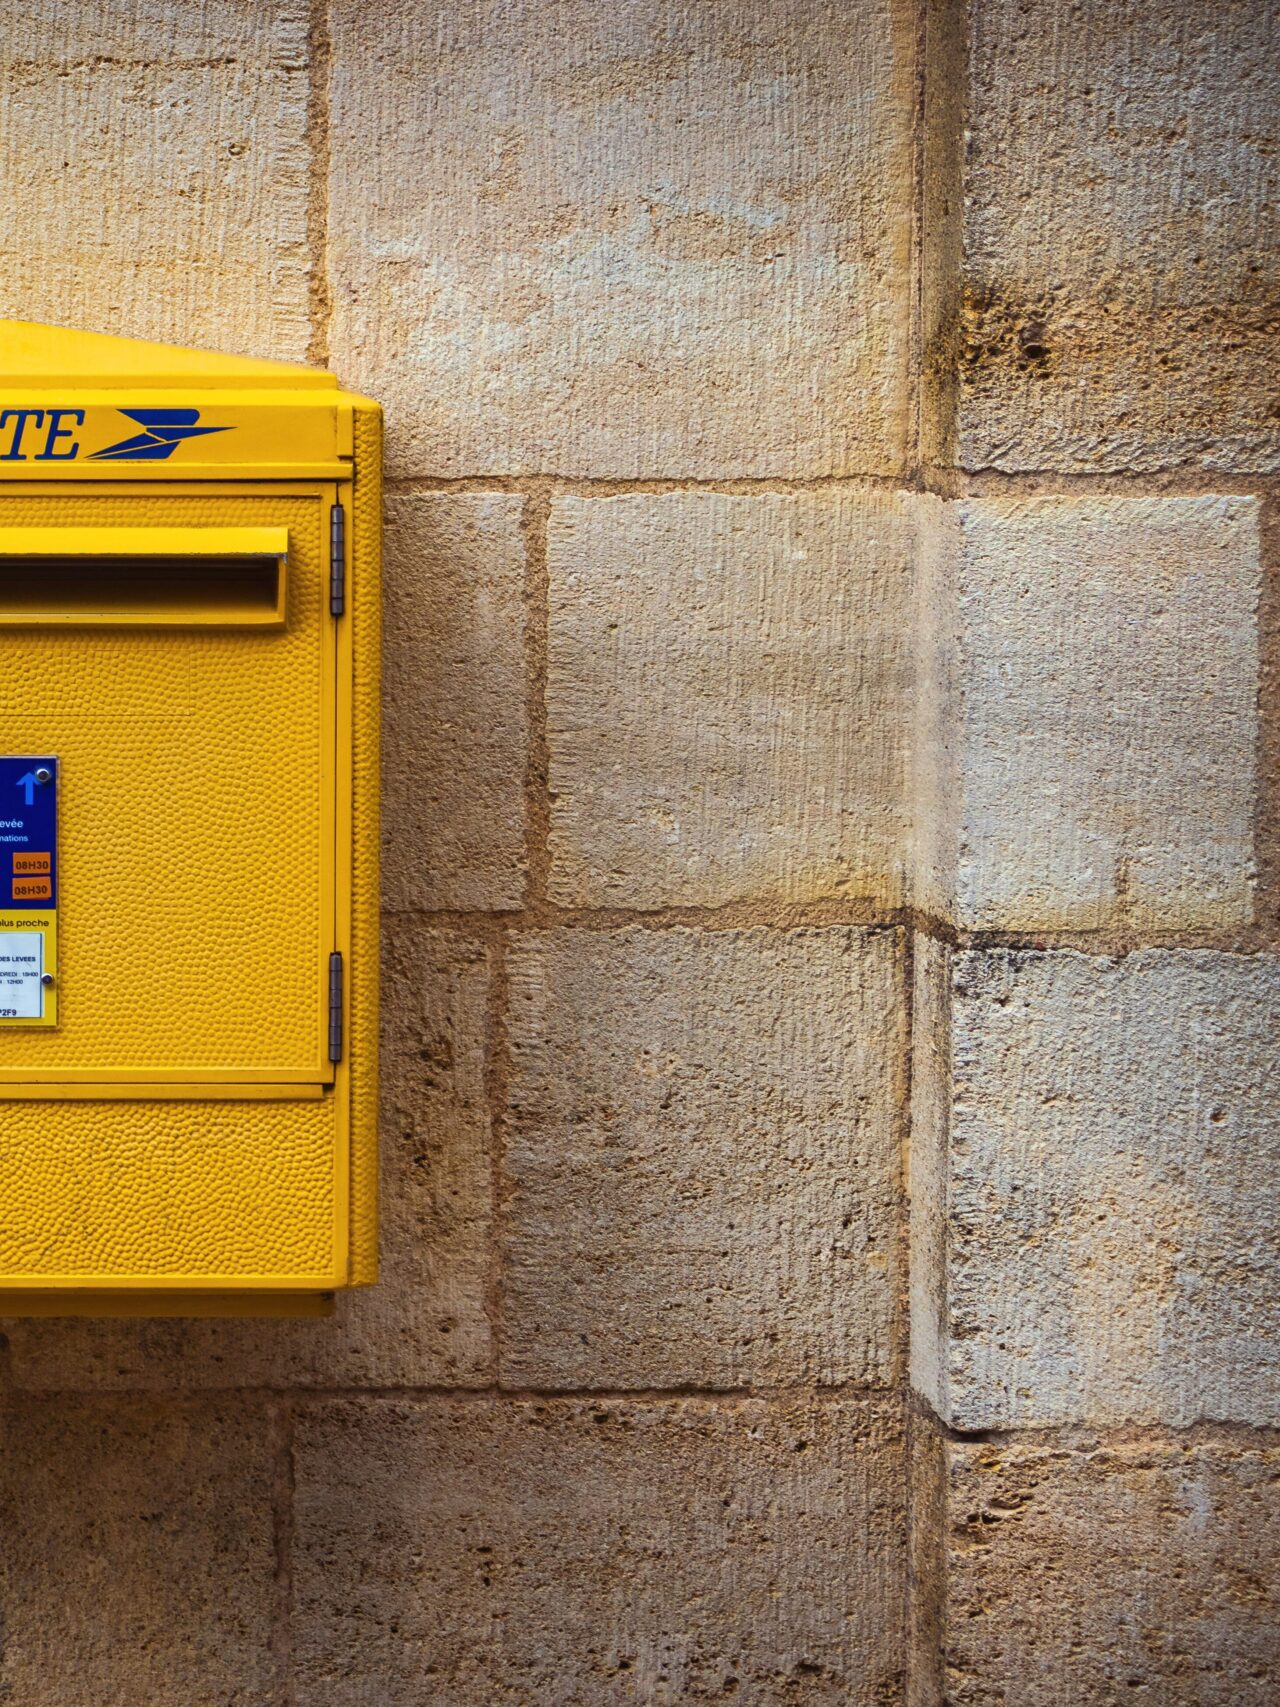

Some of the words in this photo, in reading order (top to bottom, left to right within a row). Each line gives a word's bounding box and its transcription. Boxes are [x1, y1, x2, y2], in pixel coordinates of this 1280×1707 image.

[15, 861, 48, 870] 08H30
[14, 885, 47, 895] 08H30
[16, 919, 49, 928] proche
